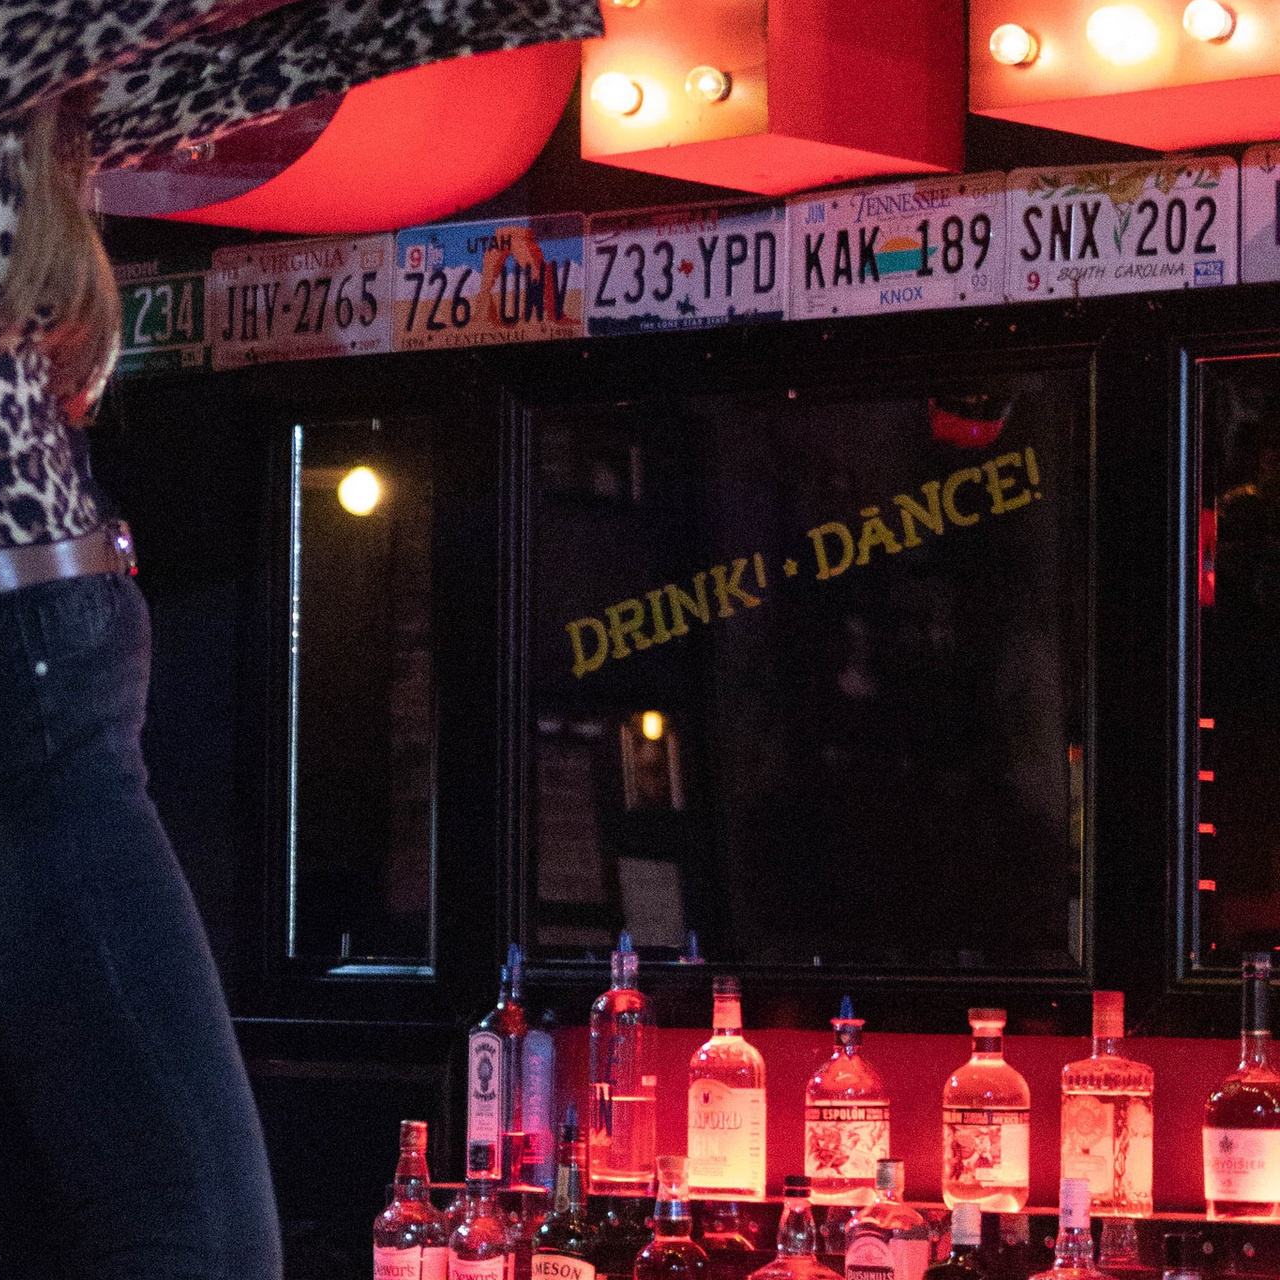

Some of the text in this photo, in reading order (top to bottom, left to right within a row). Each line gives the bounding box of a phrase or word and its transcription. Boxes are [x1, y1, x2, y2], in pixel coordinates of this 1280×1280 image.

[851, 188, 950, 222] TENNESSEE
[1020, 196, 1217, 262] SNX 202
[410, 248, 423, 269] 9
[467, 234, 512, 254] UTAH
[806, 214, 991, 290] KAK 189
[259, 248, 345, 273] VIRGINIA
[593, 230, 777, 308] Z33 YPD
[1057, 265, 1106, 282] SOUTH
[1114, 262, 1185, 279] CAROLINA
[1026, 270, 1041, 292] 9
[404, 267, 473, 333] 726
[879, 287, 923, 305] KNOX
[565, 553, 767, 679] DRINK!
